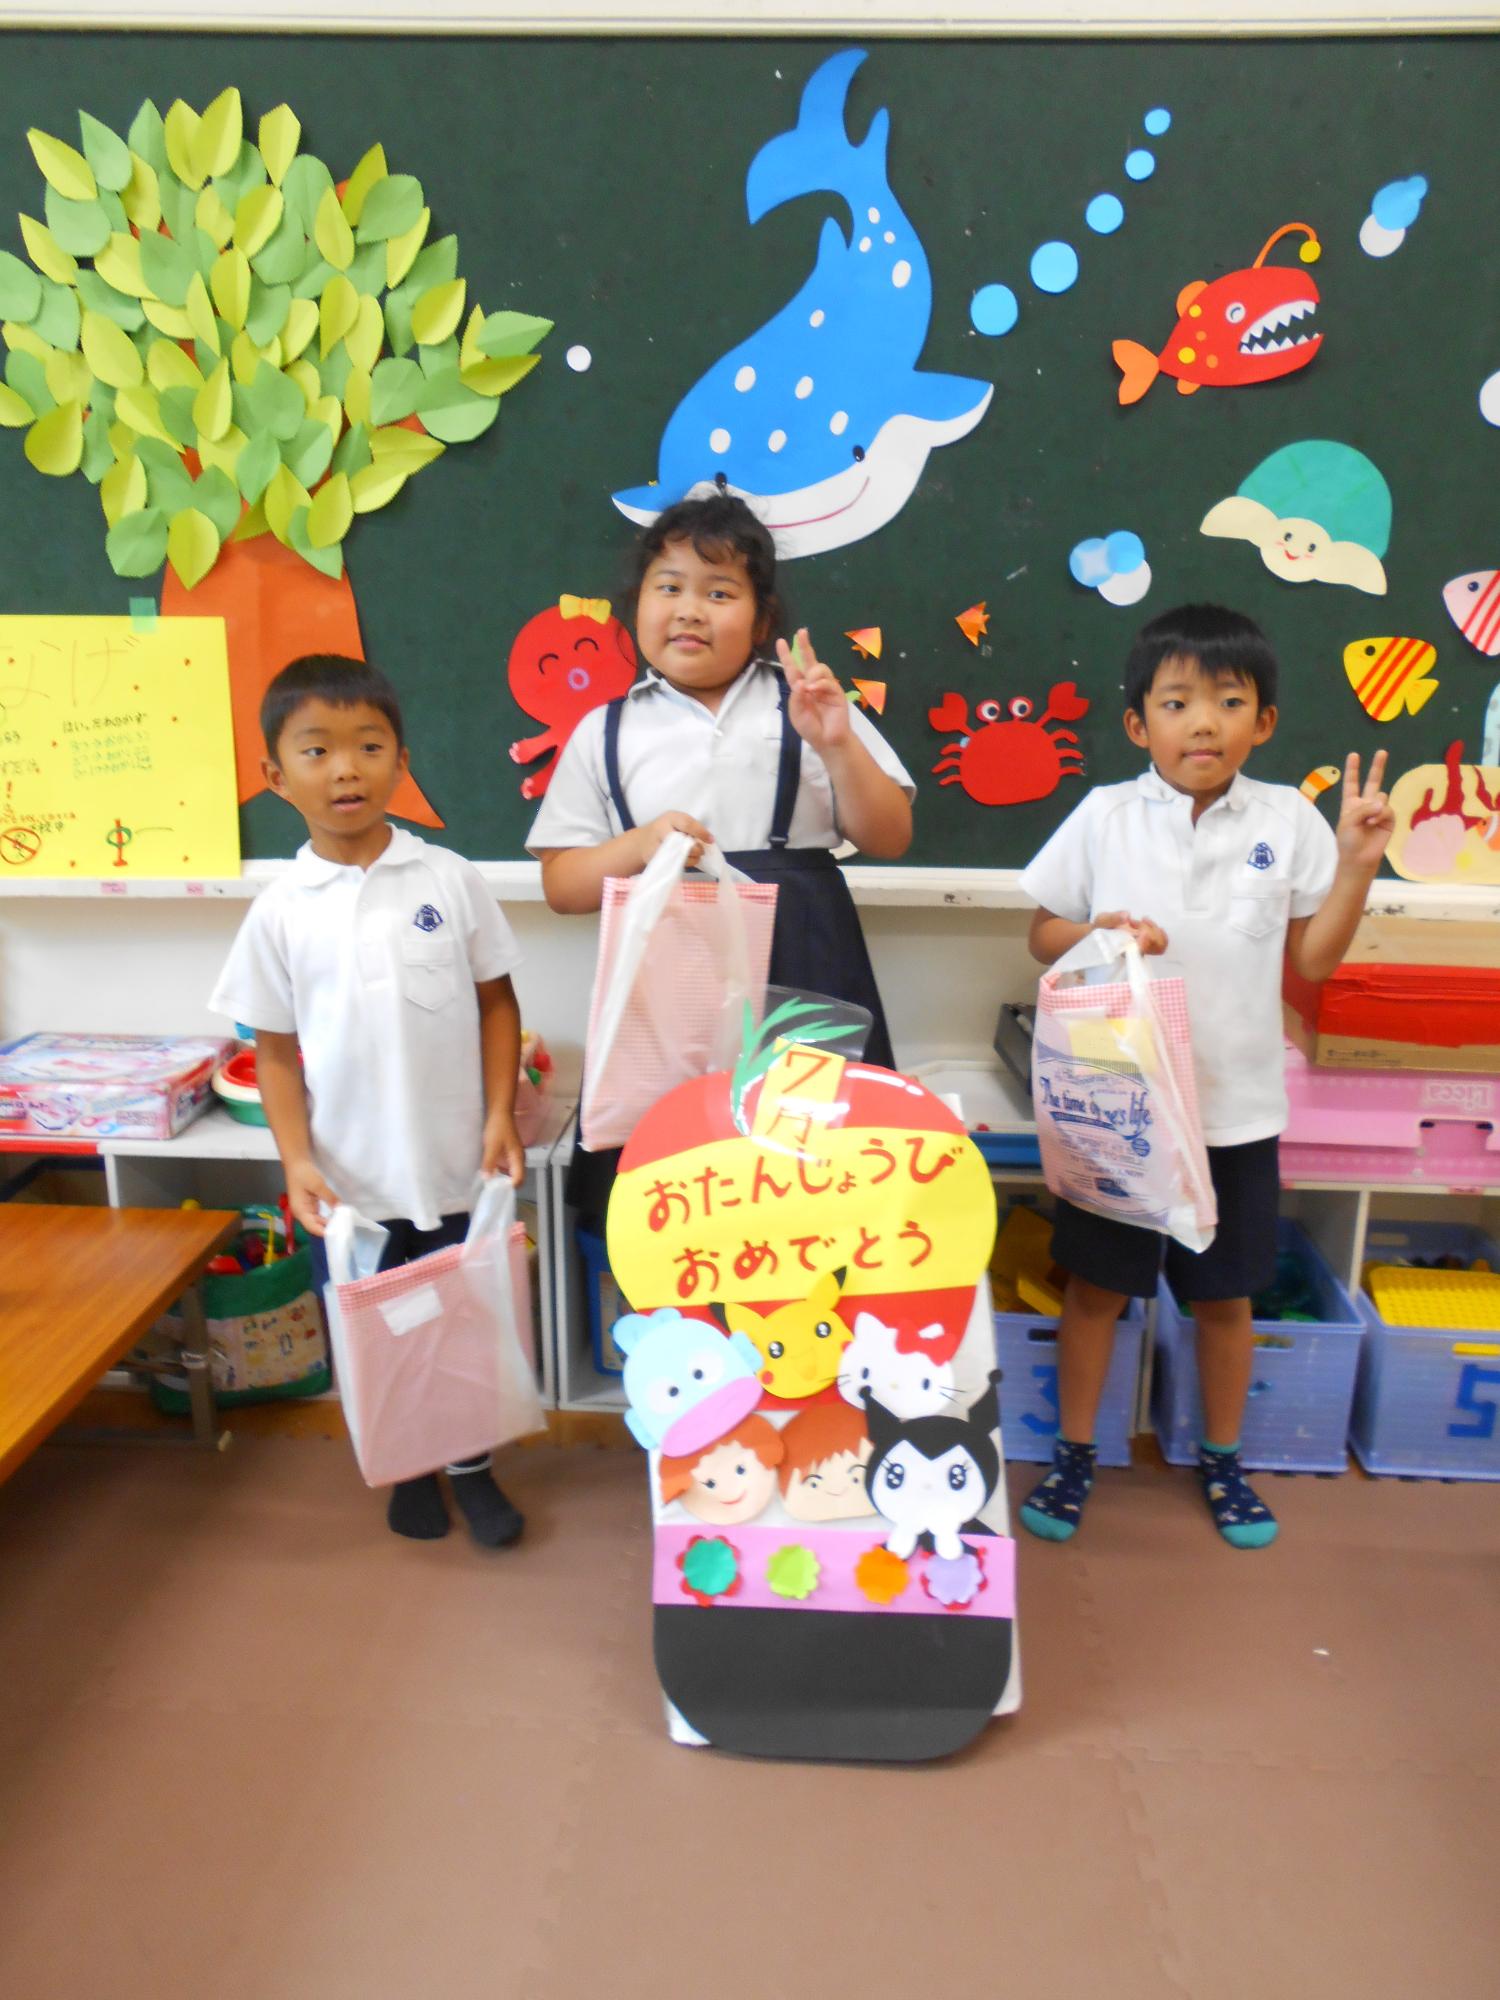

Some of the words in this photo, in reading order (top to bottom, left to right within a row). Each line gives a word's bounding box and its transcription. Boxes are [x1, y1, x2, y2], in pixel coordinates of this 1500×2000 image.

[644, 1136, 965, 1233] おたんじょうび
[672, 1219, 933, 1299] おめでとう
[1447, 1363, 1500, 1438] 5
